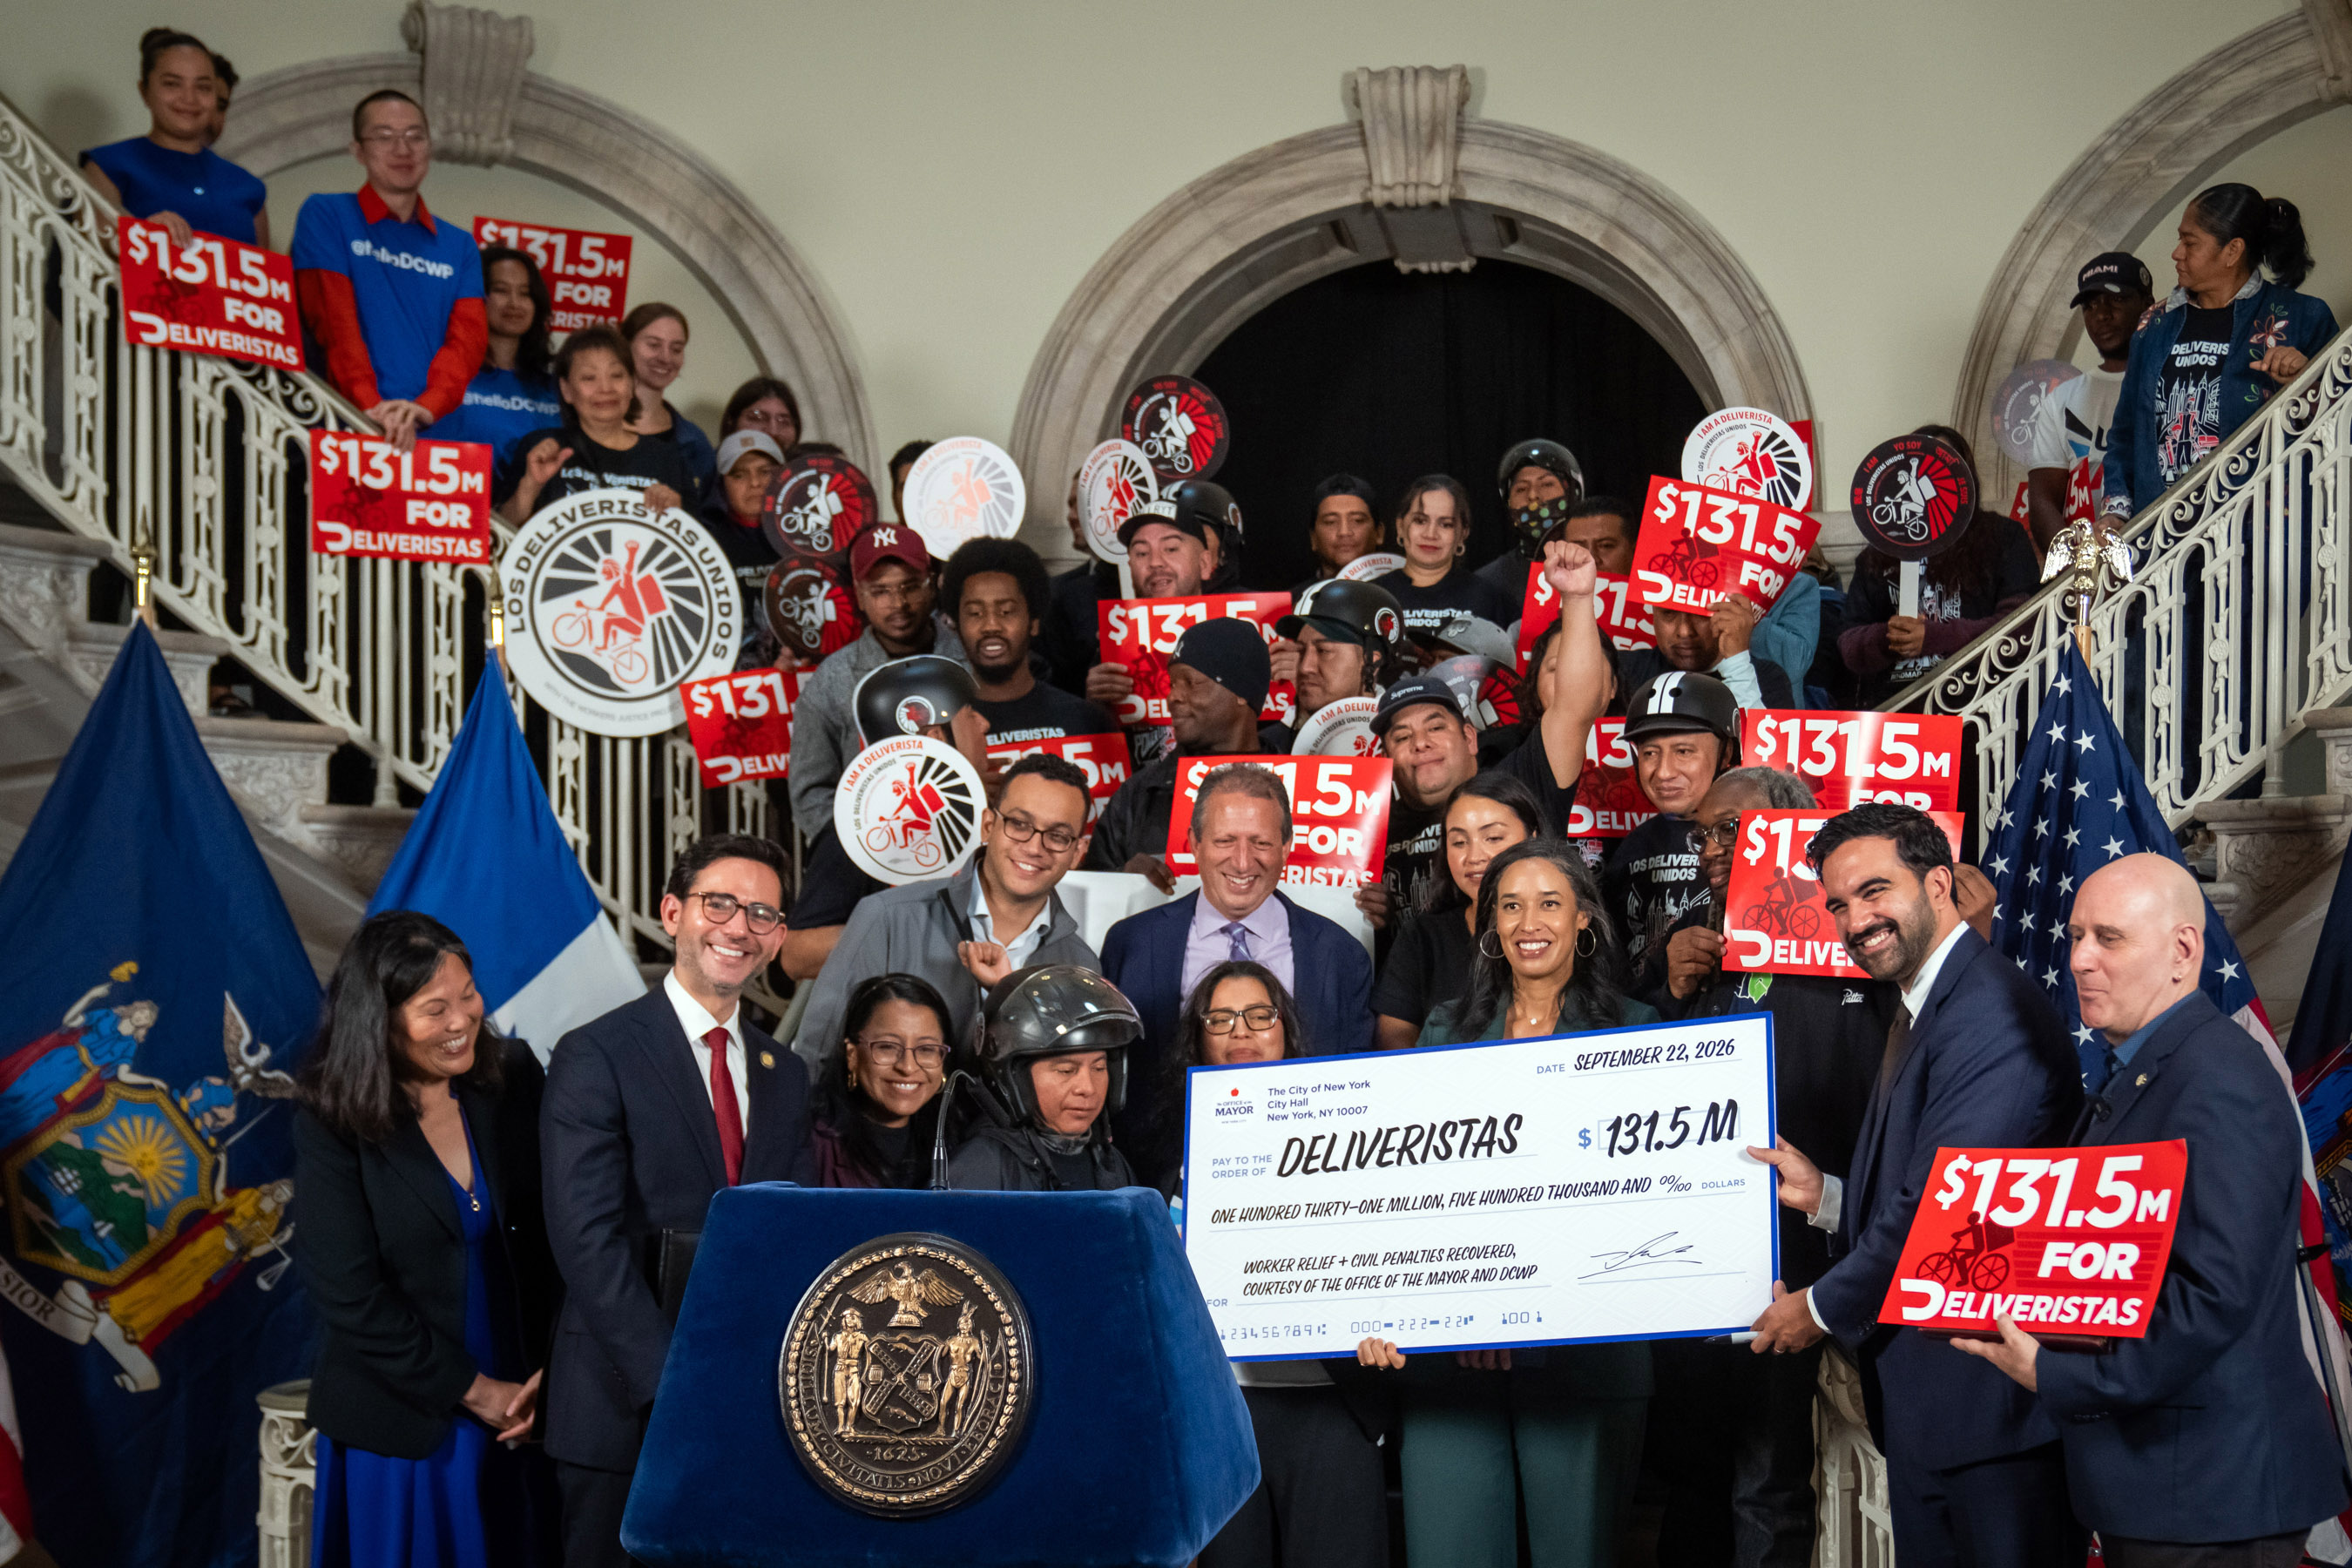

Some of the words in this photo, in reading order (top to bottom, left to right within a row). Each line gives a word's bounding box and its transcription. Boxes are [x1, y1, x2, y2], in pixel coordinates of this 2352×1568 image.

[128, 222, 292, 303] $131.5M
[2083, 265, 2119, 281] MIAMI
[554, 280, 612, 308] FOR
[224, 296, 285, 335] FOR
[128, 310, 299, 366] DELIVERISTAS
[2170, 341, 2231, 355] DELIVERIS
[2175, 353, 2218, 368] UNIDOS
[1700, 422, 1714, 436] AM
[1714, 418, 1721, 427] A
[1720, 411, 1773, 425] DELIVERISTA
[1700, 429, 1726, 460] DELIVERISTAS
[1725, 424, 1747, 433] UNIDOS
[1893, 442, 1905, 451] YO
[1906, 441, 1922, 449] SOY
[319, 434, 483, 495] $131.5M
[1866, 456, 1879, 470] AM
[1866, 463, 1887, 495] DELIVERISTAS
[1885, 453, 1905, 466] UNIDOS
[405, 499, 471, 529] FOR
[1653, 483, 1807, 570] $131.5M
[316, 520, 483, 558] DELIVERISTAS
[507, 578, 526, 634] LOS
[520, 499, 700, 575] DELIVERISTAS
[698, 547, 733, 660] UNIDOS
[1348, 557, 1393, 576] DELIVERISTA
[1739, 560, 1785, 599] FOR
[1390, 685, 1424, 700] Supreme
[1321, 710, 1336, 722] AM
[985, 727, 1066, 746] ELIVERISTAS
[1313, 719, 1347, 748] DELIVERISTAS
[1754, 714, 1951, 781] $131.5M
[847, 770, 860, 787] AM
[864, 740, 924, 767] DELIVERISTA
[873, 758, 897, 775] UNIDOS
[853, 774, 875, 815] DELIVERISTAS
[853, 818, 862, 831] LOS
[1290, 825, 1364, 856] FOR
[1629, 858, 1648, 875] LOS
[1651, 868, 1697, 883] UNIDOS
[1731, 929, 1855, 968] DELIVE
[1842, 988, 1865, 1006] Patta
[1537, 1064, 1565, 1074] DATE
[1574, 1045, 1663, 1071] SEPTEMBER
[1666, 1044, 1690, 1064] 22,
[1694, 1038, 1735, 1058] 2026
[1267, 1087, 1286, 1097] The
[1288, 1085, 1308, 1098] City
[1310, 1084, 1321, 1093] of
[1324, 1083, 1347, 1092] New
[1348, 1079, 1371, 1091] York
[1214, 1105, 1254, 1117] MAYOR
[1267, 1098, 1288, 1110] City
[1289, 1098, 1308, 1107] Hall
[1267, 1112, 1290, 1122] New
[1292, 1110, 1317, 1121] York,
[1319, 1108, 1335, 1118] NY
[1336, 1105, 1369, 1117] 10007
[1578, 1127, 1592, 1150] $
[1605, 1105, 1692, 1159] 131.5
[1696, 1098, 1738, 1146] M
[1212, 1156, 1232, 1167] PAY
[1234, 1156, 1248, 1166] TO
[1252, 1154, 1273, 1165] THE
[1277, 1113, 1524, 1178] DELIVERISTAS
[1212, 1169, 1248, 1179] ORDER
[1252, 1167, 1267, 1177] OF
[1211, 1208, 1238, 1225] ONE
[1239, 1204, 1301, 1223] HUNDRED
[1386, 1193, 1445, 1213] MILLION,
[1449, 1190, 1477, 1208] FIVE
[1479, 1186, 1544, 1206] HUNDRED
[1548, 1179, 1619, 1200] THOUSAND
[1621, 1176, 1652, 1195] AND
[1701, 1178, 1746, 1190] DOLLARS
[1935, 1154, 2173, 1229] $131.5M
[1244, 1258, 1296, 1274] WORKER
[1297, 1254, 1338, 1271] RELIEF
[1338, 1255, 1349, 1267] +
[1351, 1252, 1381, 1269] CIVIL
[1382, 1247, 1443, 1266] PENALTIES
[1446, 1243, 1517, 1262] RECOVERED,
[2037, 1242, 2141, 1281] FOR
[1243, 1280, 1301, 1297] COURTESY
[1303, 1279, 1318, 1294] OF
[1321, 1277, 1342, 1292] THE
[1344, 1274, 1382, 1291] OFFICE
[1384, 1274, 1398, 1288] OF
[1402, 1272, 1423, 1287] THE
[1424, 1269, 1470, 1287] MAYOR
[1470, 1267, 1497, 1283] AND
[1498, 1264, 1538, 1281] DCWP
[1206, 1298, 1228, 1308] FOR
[1900, 1278, 2144, 1326] DELIVERISTAS
[822, 1442, 906, 1489] CIVITATIS
[916, 1452, 962, 1486] NOVI
[874, 1446, 921, 1463] 1625
